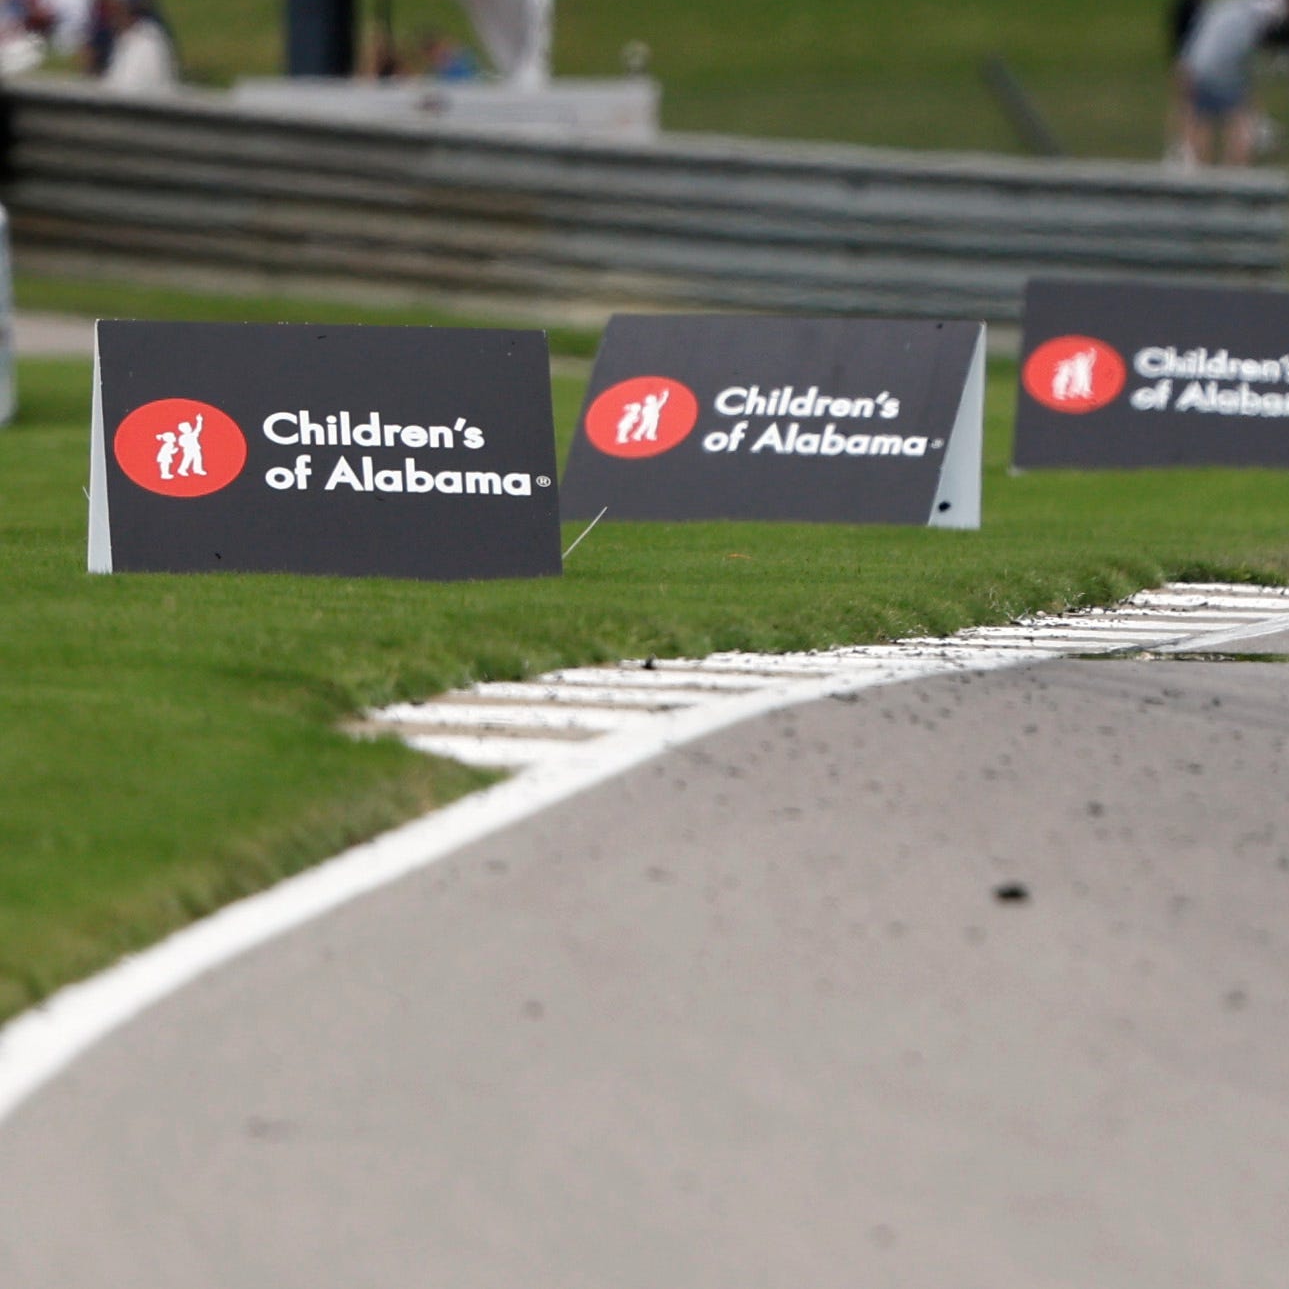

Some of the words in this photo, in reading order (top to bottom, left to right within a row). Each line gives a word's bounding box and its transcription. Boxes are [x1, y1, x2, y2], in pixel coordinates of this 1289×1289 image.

[713, 385, 900, 419] Children's
[1130, 378, 1174, 412] of
[263, 411, 485, 450] Children's
[702, 421, 750, 453] of
[265, 455, 312, 491] of
